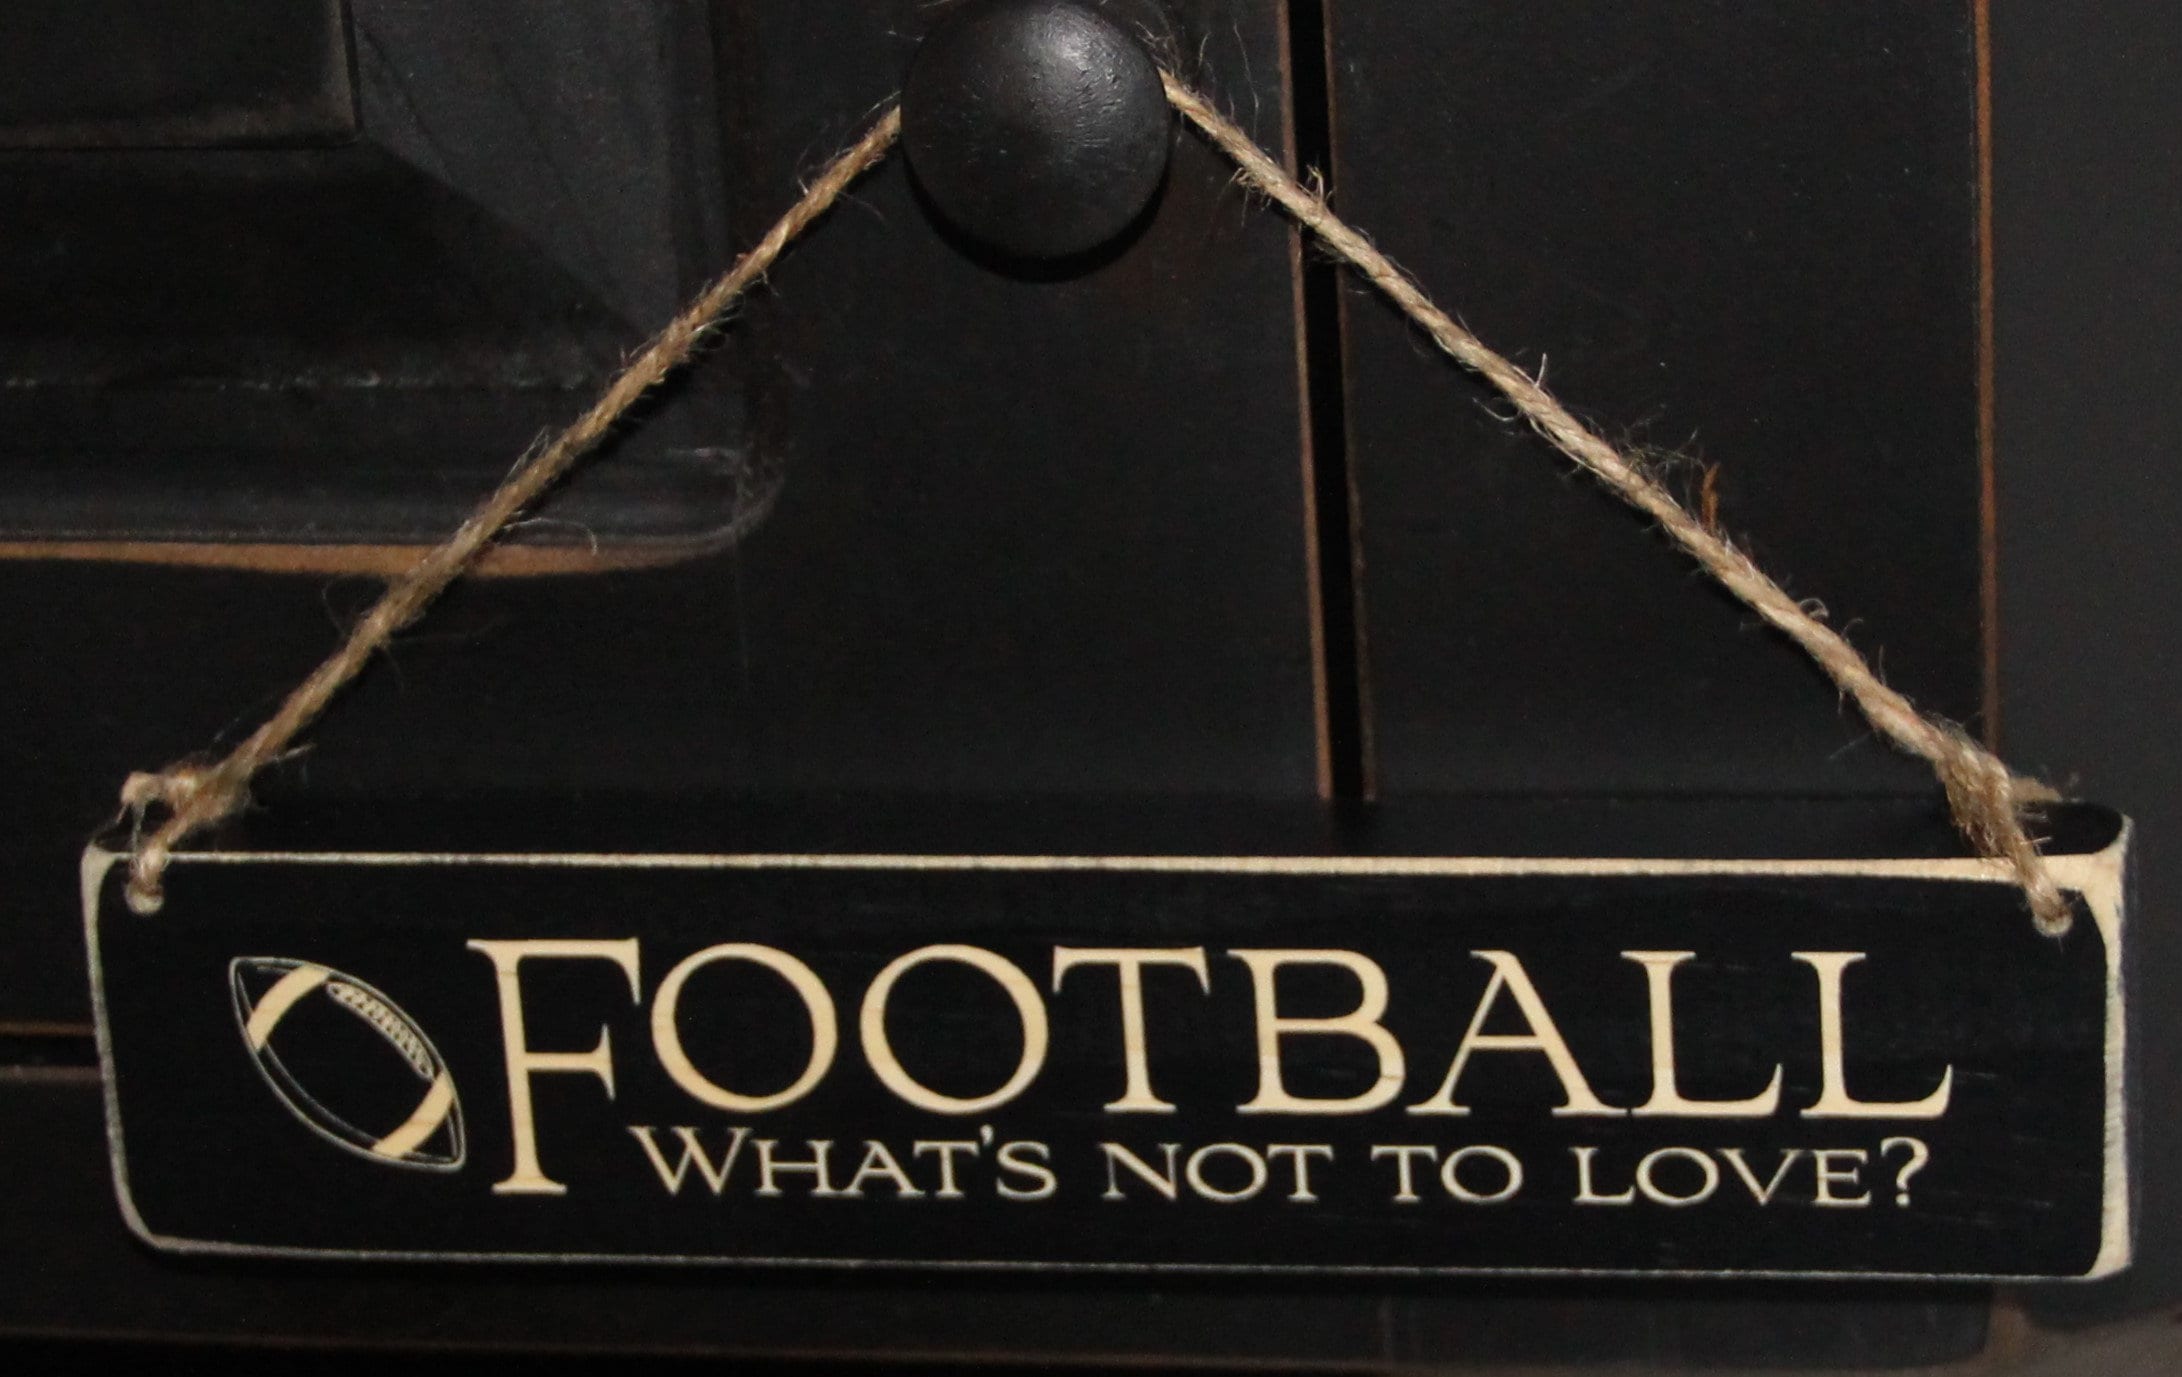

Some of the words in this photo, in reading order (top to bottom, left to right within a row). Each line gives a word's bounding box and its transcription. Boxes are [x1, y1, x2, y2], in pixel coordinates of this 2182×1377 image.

[465, 937, 1953, 1196] FOOTBALL
[628, 1124, 1056, 1199] WHAT'S
[1102, 1142, 1333, 1203] NOT
[1370, 1144, 1523, 1204] TO
[1573, 1136, 1929, 1207] LOVE?
